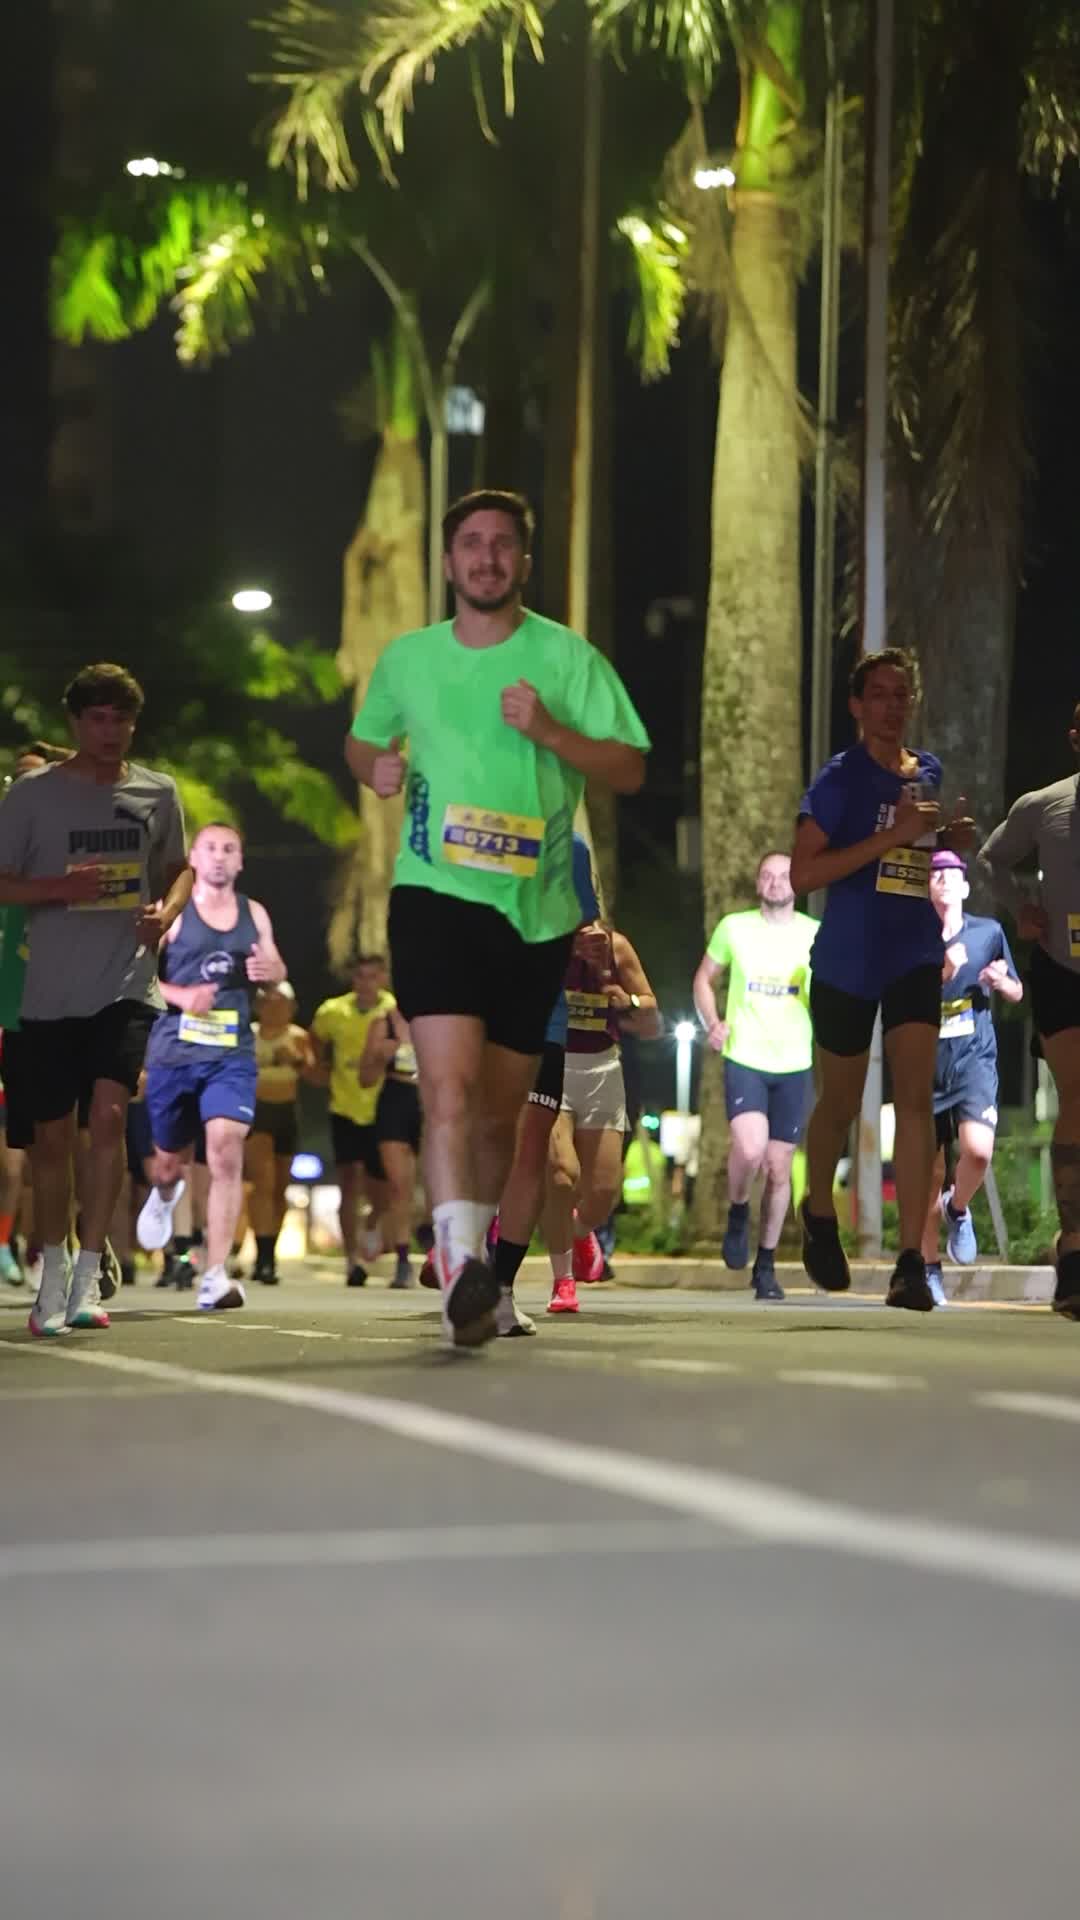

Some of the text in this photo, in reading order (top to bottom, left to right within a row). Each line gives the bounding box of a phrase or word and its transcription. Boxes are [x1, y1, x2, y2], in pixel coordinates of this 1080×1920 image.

[69, 828, 140, 853] PUMA
[465, 831, 519, 852] 6713
[568, 1007, 594, 1016] 244
